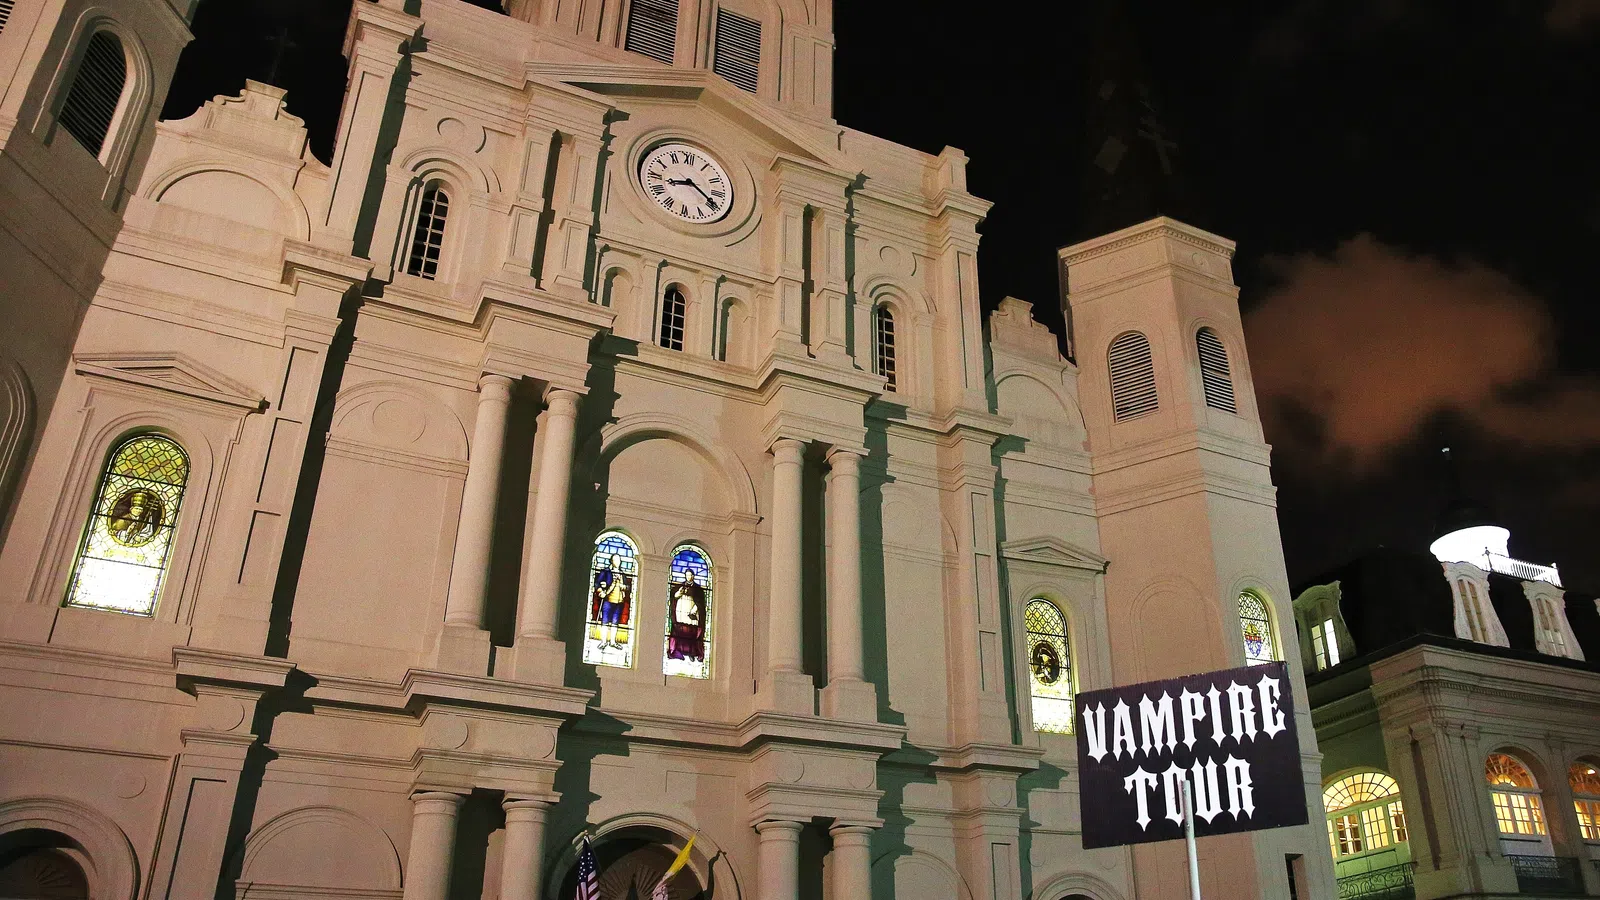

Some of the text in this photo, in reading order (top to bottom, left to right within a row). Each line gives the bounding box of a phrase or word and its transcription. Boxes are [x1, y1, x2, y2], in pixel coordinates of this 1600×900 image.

[684, 153, 694, 166] XII
[1082, 673, 1286, 763] VAMPIRE
[1124, 753, 1256, 832] TOUR
